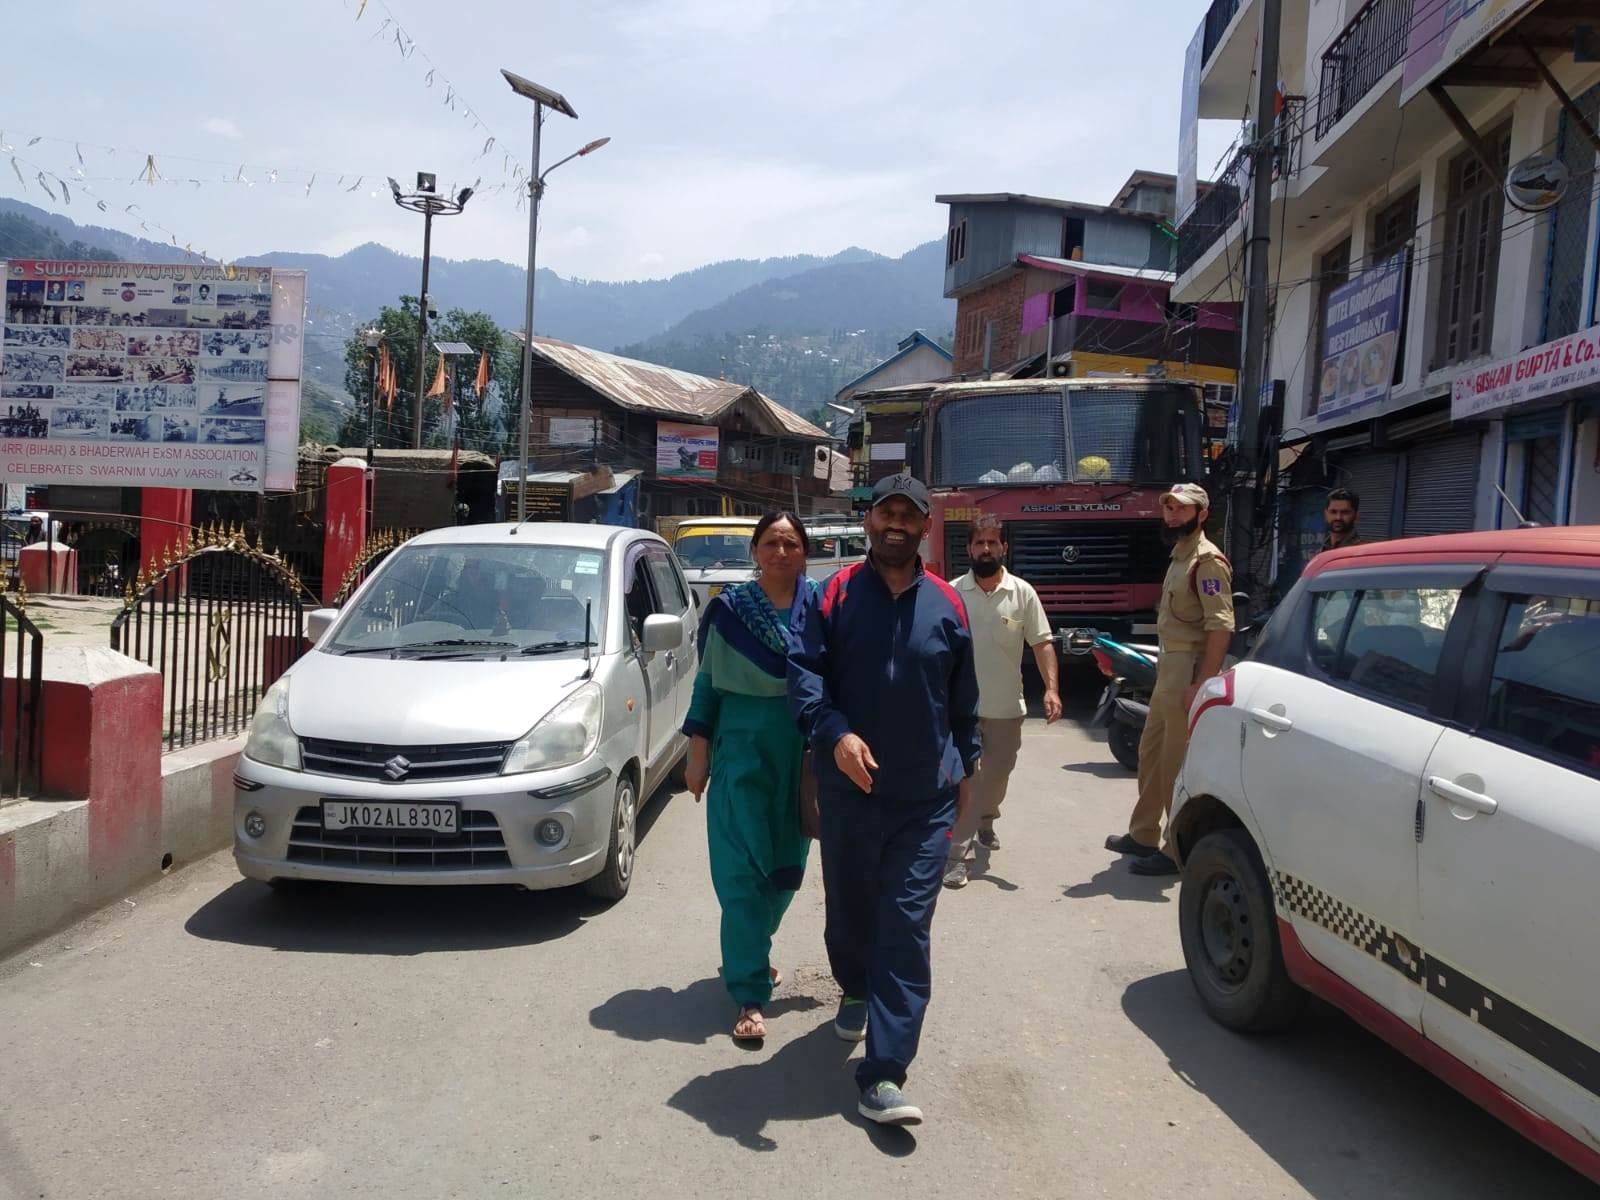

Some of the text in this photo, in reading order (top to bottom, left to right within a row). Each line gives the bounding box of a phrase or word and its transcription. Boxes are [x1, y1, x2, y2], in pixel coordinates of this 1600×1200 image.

[34, 262, 129, 278] SWARNIM
[134, 264, 186, 280] VIJAY
[1515, 346, 1561, 383] GUPTA
[1562, 343, 1573, 368] &
[25, 443, 67, 458] (BIHAR)
[69, 445, 77, 457] &
[79, 445, 149, 460] BHADERWAH
[185, 448, 258, 462] ASSOCIATION
[7, 462, 223, 480] CELEBRATES SWARNIM VIJAY VARSH
[1022, 503, 1121, 513] ASHOK LEYLAND
[339, 807, 453, 827] JK02AL8302
